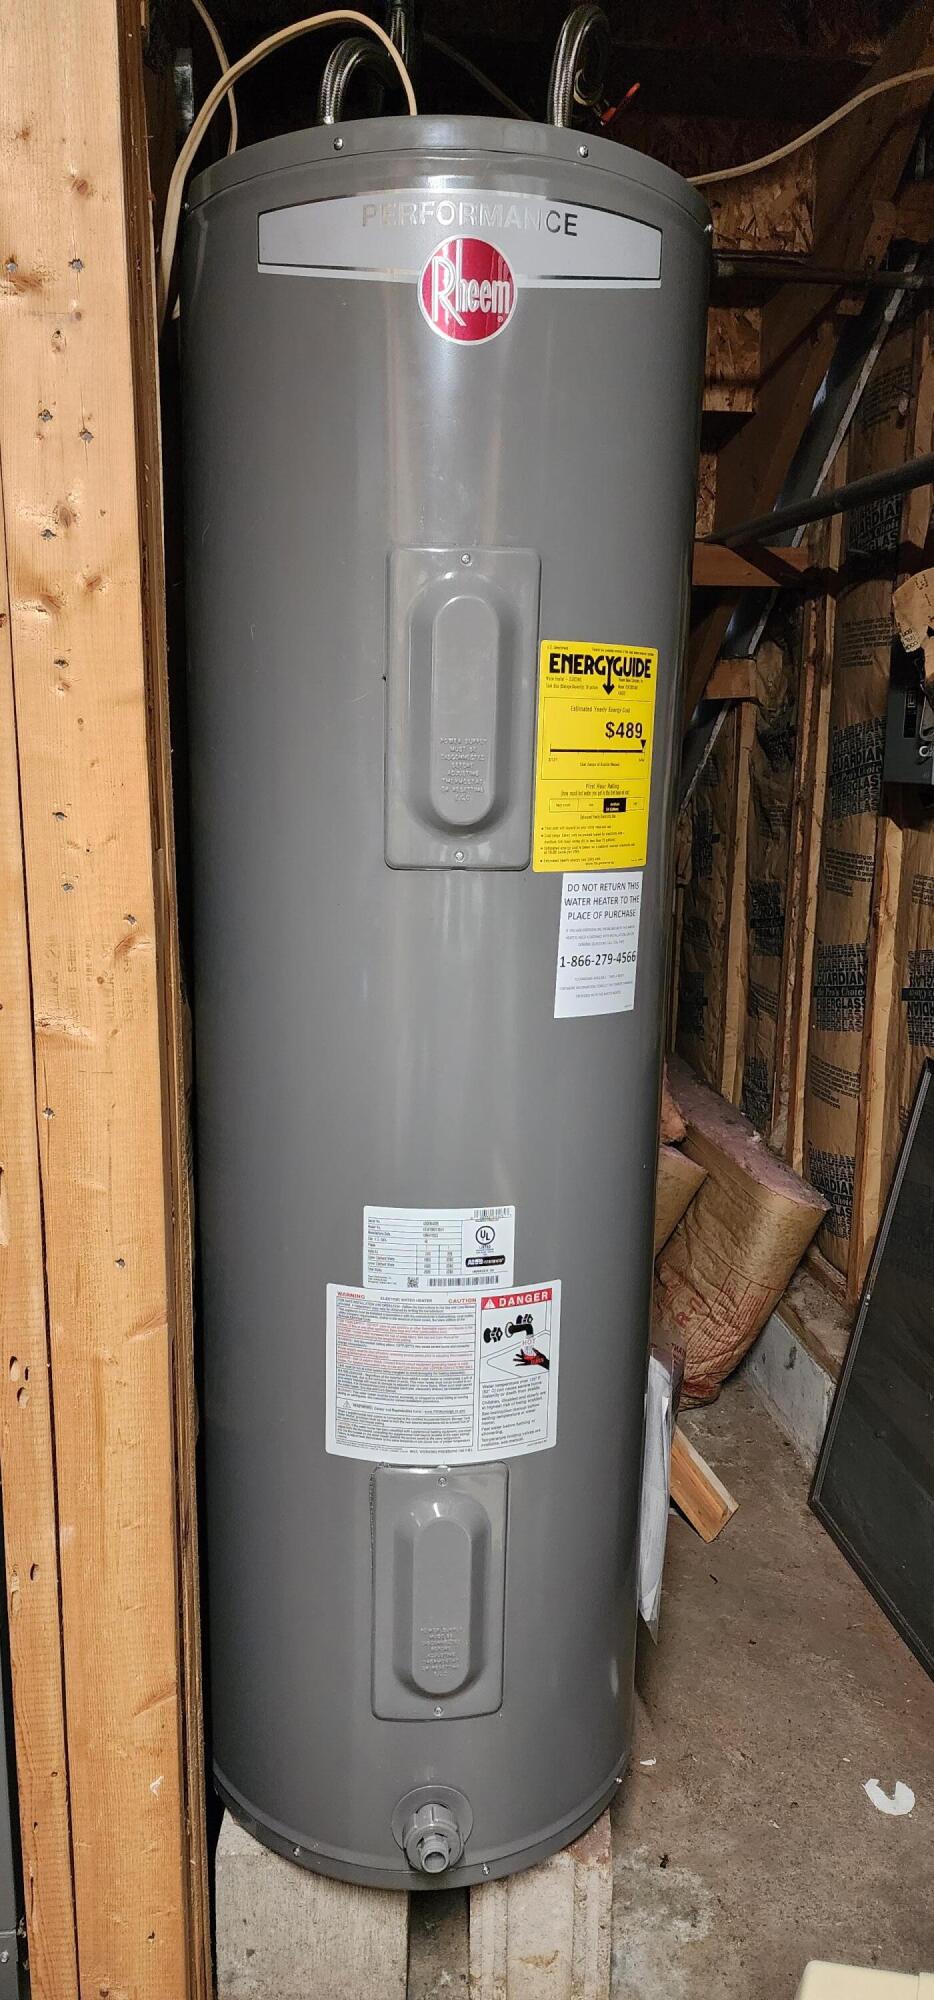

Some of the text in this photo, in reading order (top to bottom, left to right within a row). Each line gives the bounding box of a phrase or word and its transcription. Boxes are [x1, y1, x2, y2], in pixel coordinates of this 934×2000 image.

[362, 201, 578, 237] PERFORMANCE
[431, 239, 511, 327] Rheem
[549, 653, 652, 679] ENERGYGUIDE
[605, 721, 643, 740] $489
[567, 882, 640, 892] DO NOT RETURN THIS
[564, 895, 640, 906] WATER HEATER TO THE
[568, 910, 636, 920] PLACE OF PURCHASE
[560, 951, 636, 968] 1-866-279-4566
[336, 1292, 366, 1300] WARNING
[499, 1291, 548, 1307] DANGER
[522, 1338, 537, 1346] HOT
